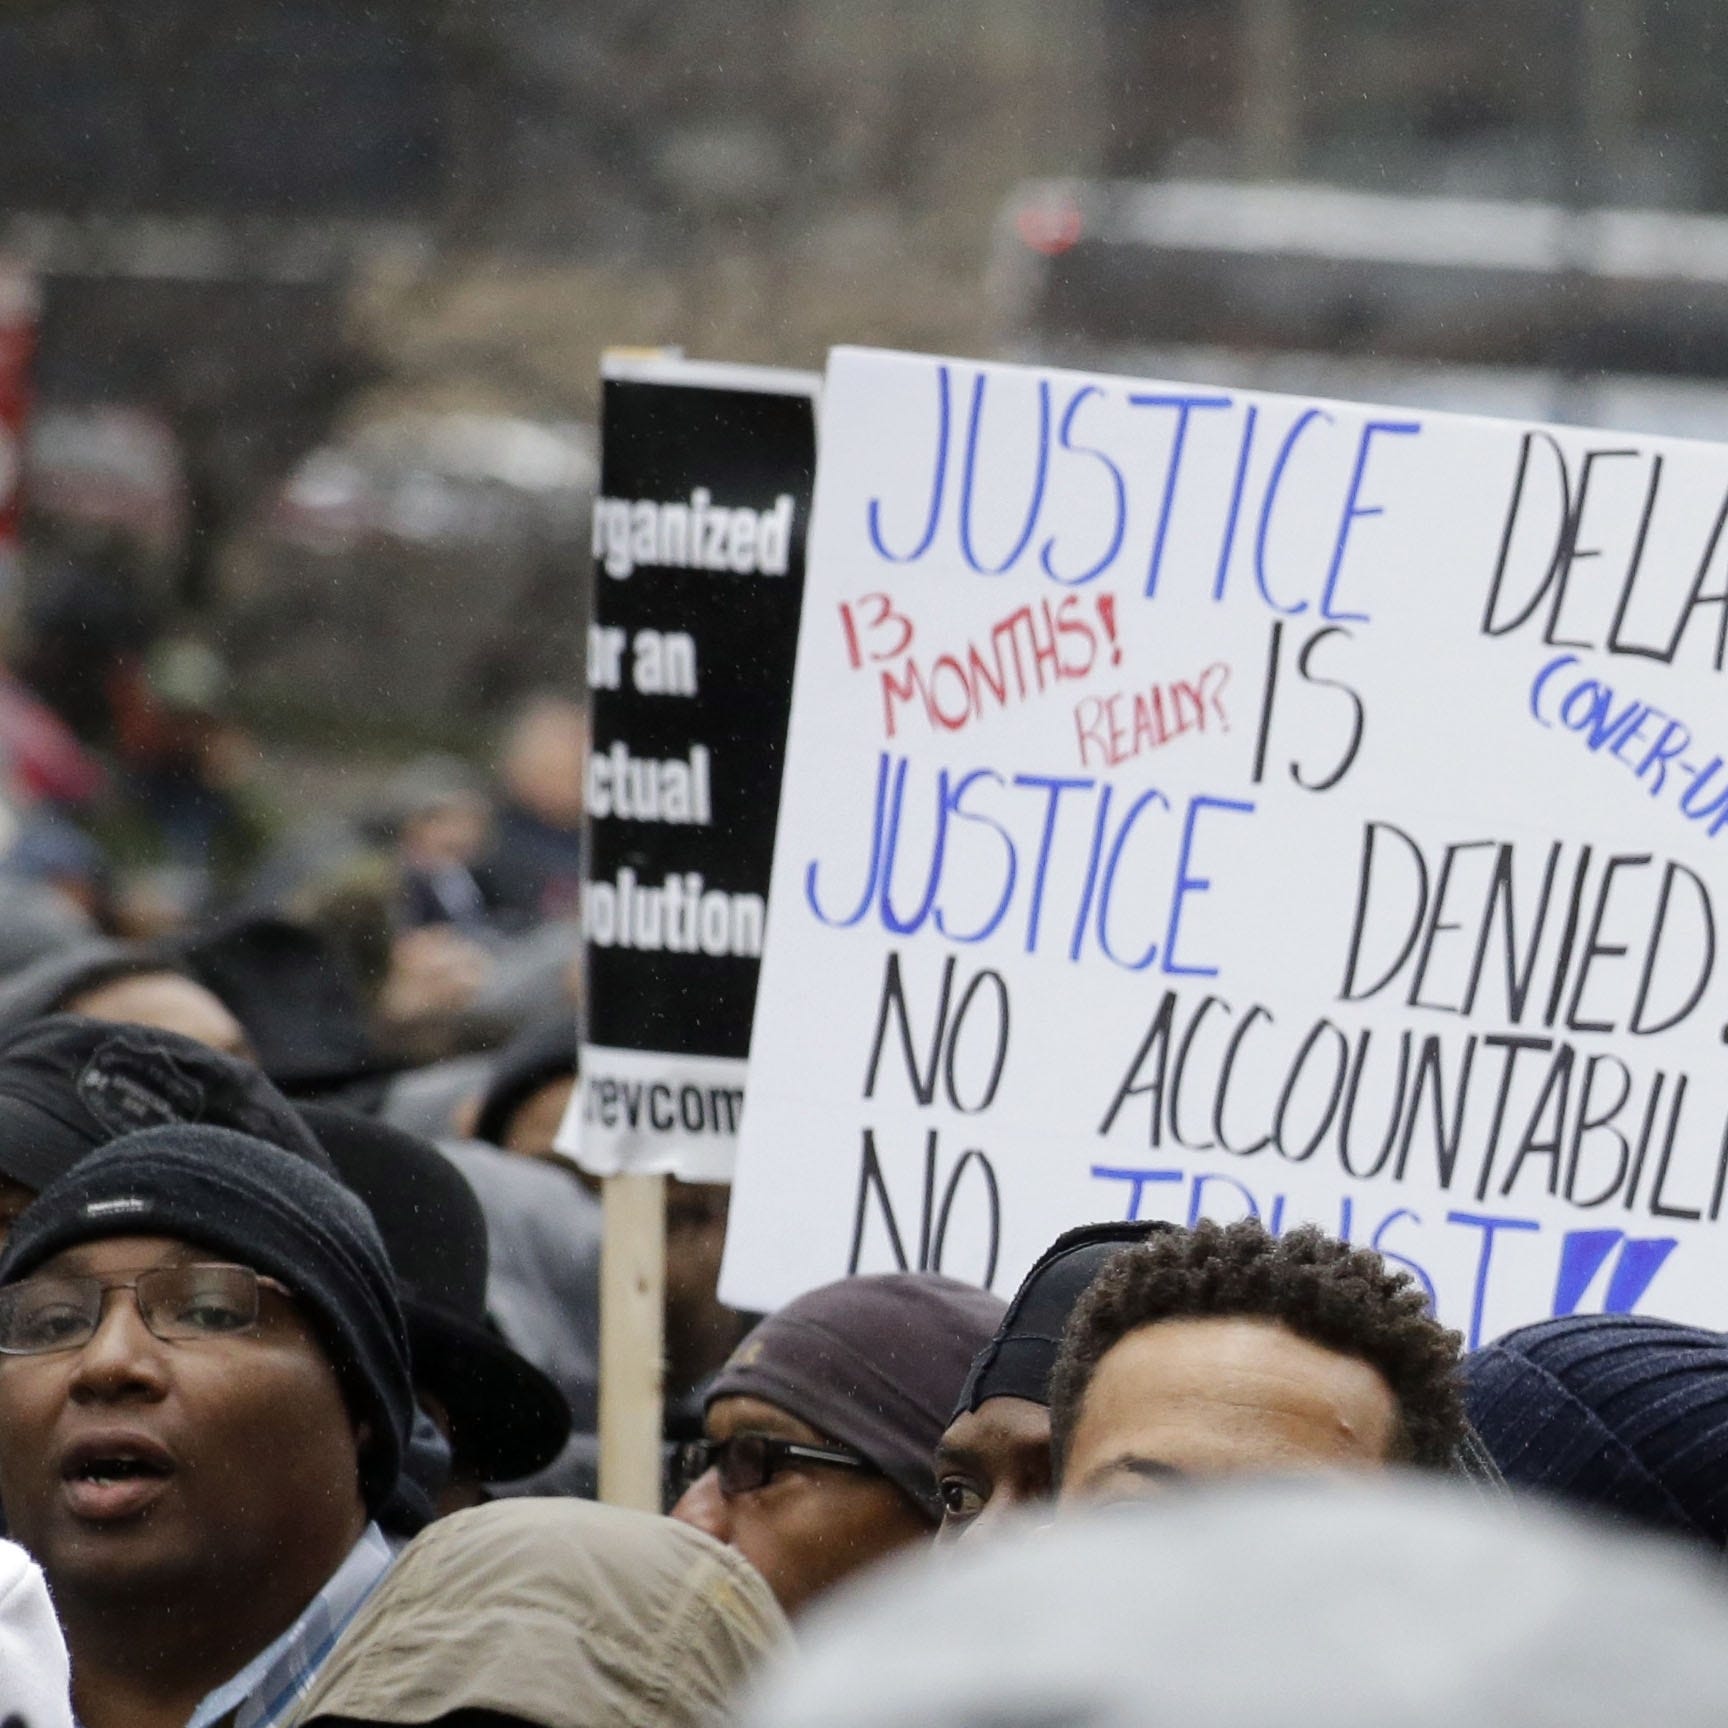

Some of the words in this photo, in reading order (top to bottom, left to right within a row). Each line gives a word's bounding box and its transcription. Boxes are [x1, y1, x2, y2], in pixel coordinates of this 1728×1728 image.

[868, 365, 1421, 623] JUSTICE
[632, 627, 698, 699] an
[837, 591, 914, 670] 13
[880, 592, 1123, 740] MONTHS!
[1252, 619, 1365, 793] IS
[1073, 662, 1232, 769] REALLY?
[804, 750, 1255, 978] JUSTICE
[862, 950, 1011, 1114] NO
[847, 1127, 1003, 1291] NO
